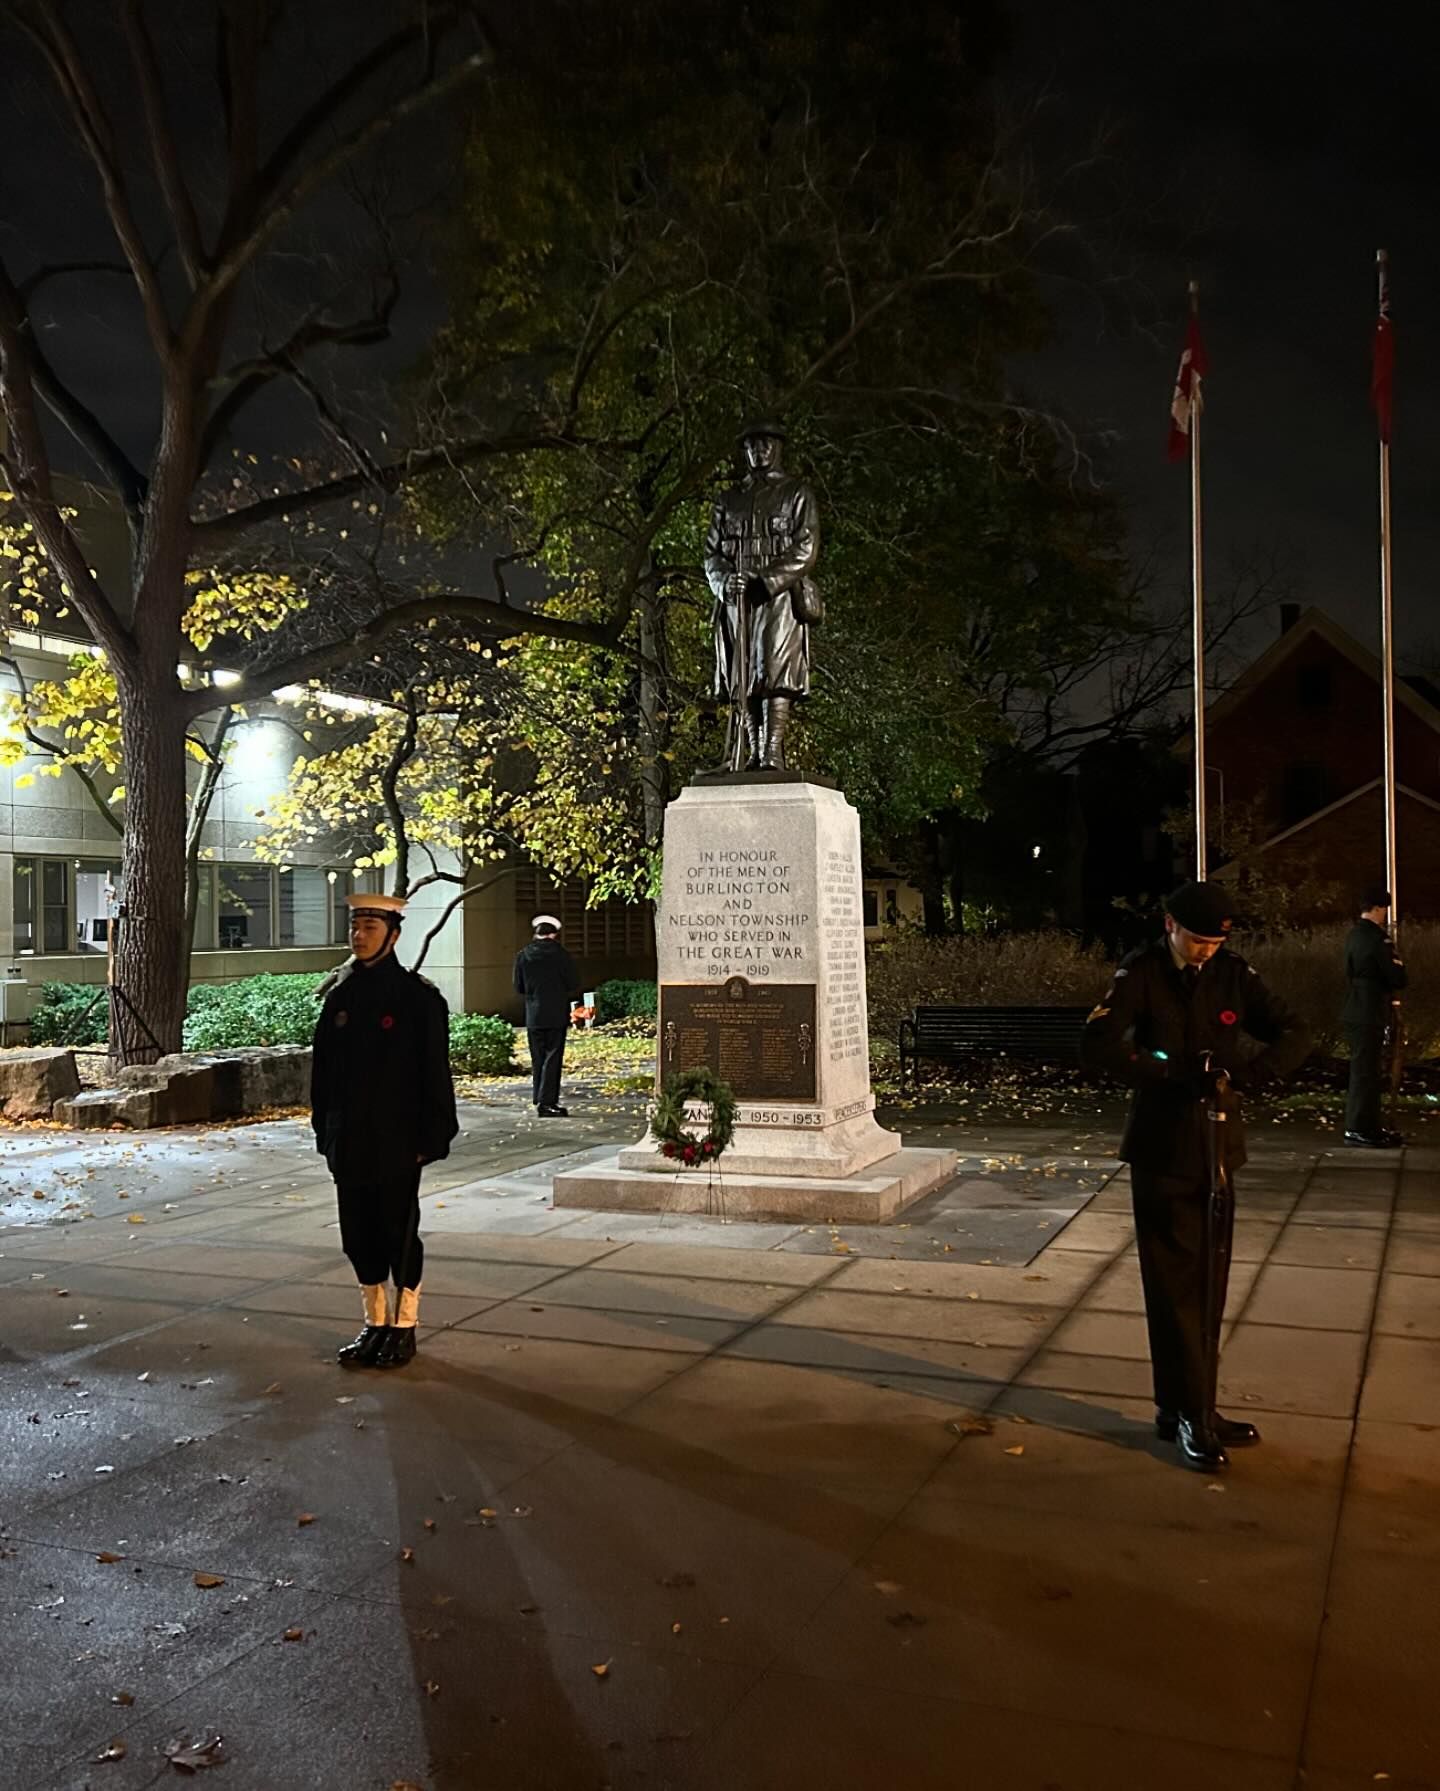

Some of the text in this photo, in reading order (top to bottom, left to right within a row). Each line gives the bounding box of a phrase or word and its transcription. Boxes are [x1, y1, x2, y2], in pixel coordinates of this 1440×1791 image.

[701, 850, 778, 862] IN HONOUR
[687, 866, 790, 878] OF THE MEN OF
[686, 882, 790, 895] BURLINGTON
[723, 899, 752, 910] AND
[669, 914, 809, 927] NELSON TOWNSHIP
[688, 931, 791, 942] WHO SERVED IN
[677, 946, 803, 959] THE GREAT WAR
[707, 964, 730, 976] 1914
[746, 964, 770, 976] 1919
[751, 1111, 779, 1123] 1950
[793, 1112, 822, 1125] 1953
